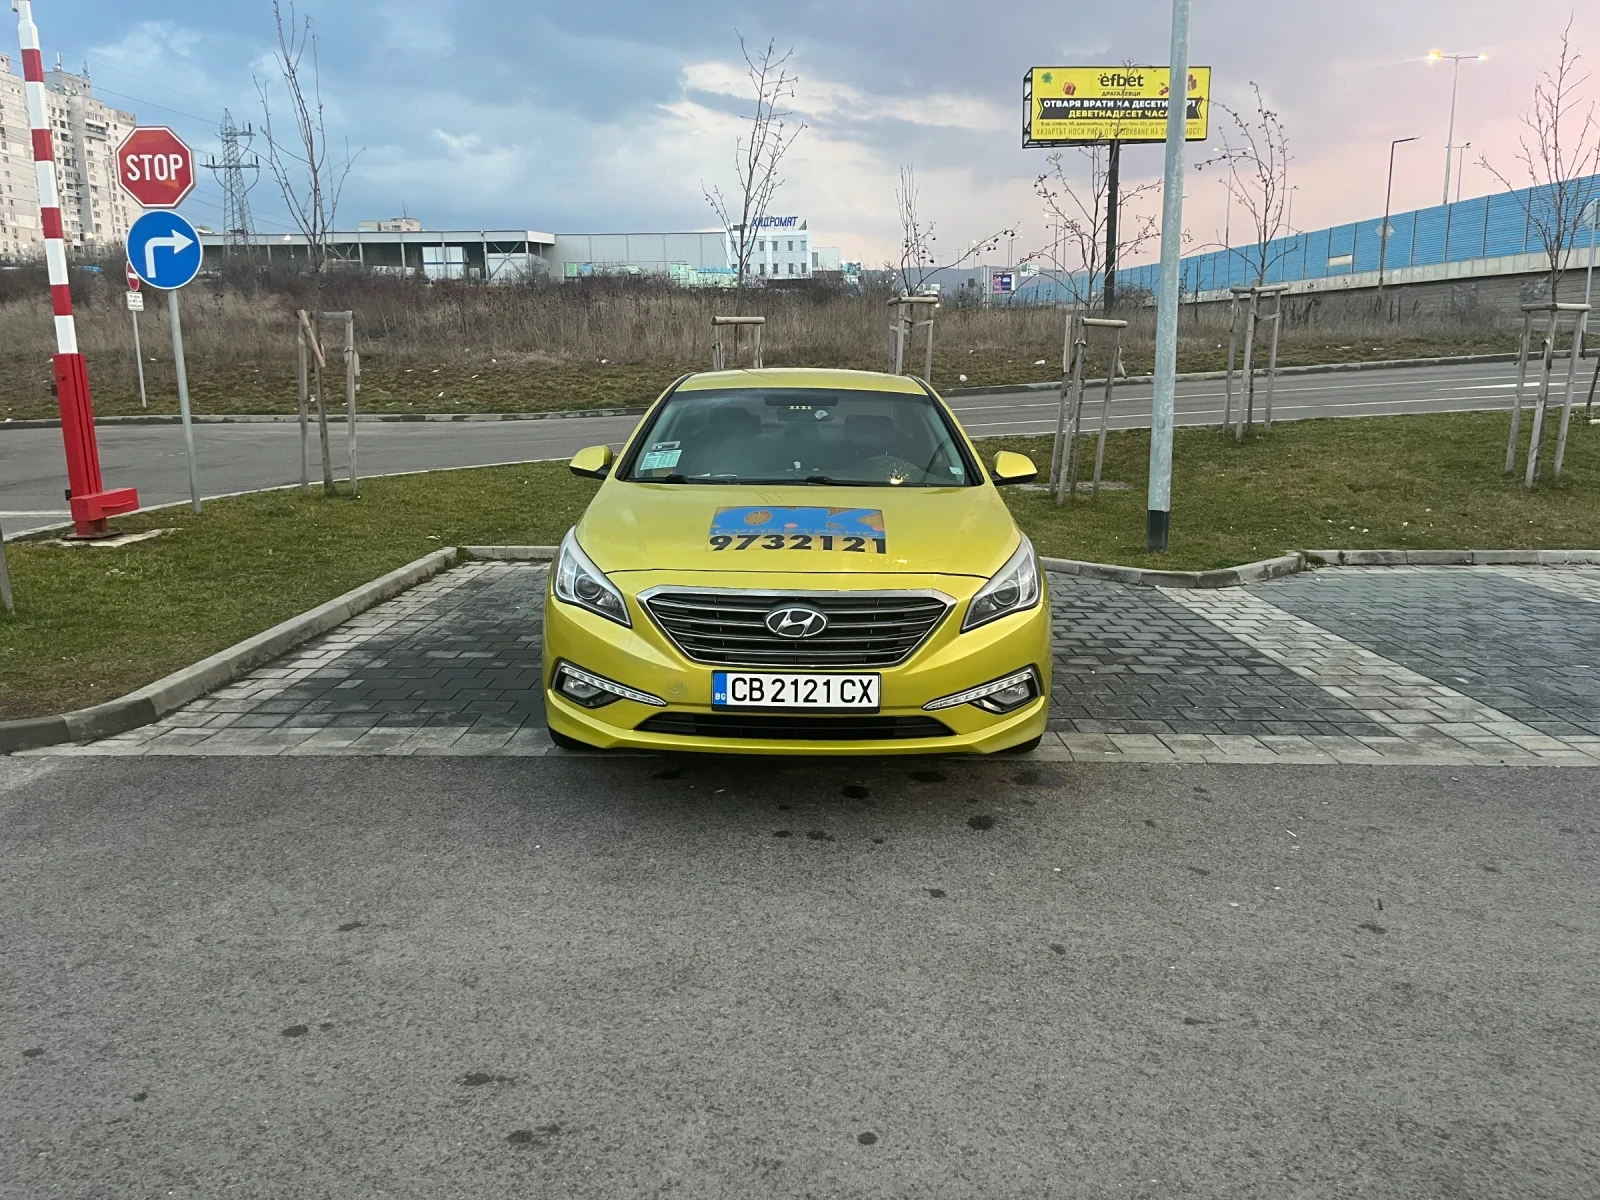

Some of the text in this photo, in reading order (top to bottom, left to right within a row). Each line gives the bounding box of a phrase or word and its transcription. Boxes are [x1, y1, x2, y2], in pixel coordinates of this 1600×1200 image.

[1098, 73, 1144, 87] efbet
[1043, 100, 1081, 108] ОТВАРЯ
[1083, 100, 1114, 108] ВРАТИ
[1116, 100, 1130, 108] НА
[1131, 100, 1168, 109] ДЕСЕТИ
[1068, 110, 1143, 118] ДЕВЕТНАДЕСЕТ
[1037, 127, 1066, 136] ХАЗАРТЪТ
[1068, 127, 1085, 136] НОСИ
[1114, 127, 1148, 136] ЗВИВАНЕ
[126, 153, 183, 181] STOP
[709, 534, 887, 555] 9732121
[715, 692, 726, 700] BG
[731, 677, 873, 704] CB 2121 CX
